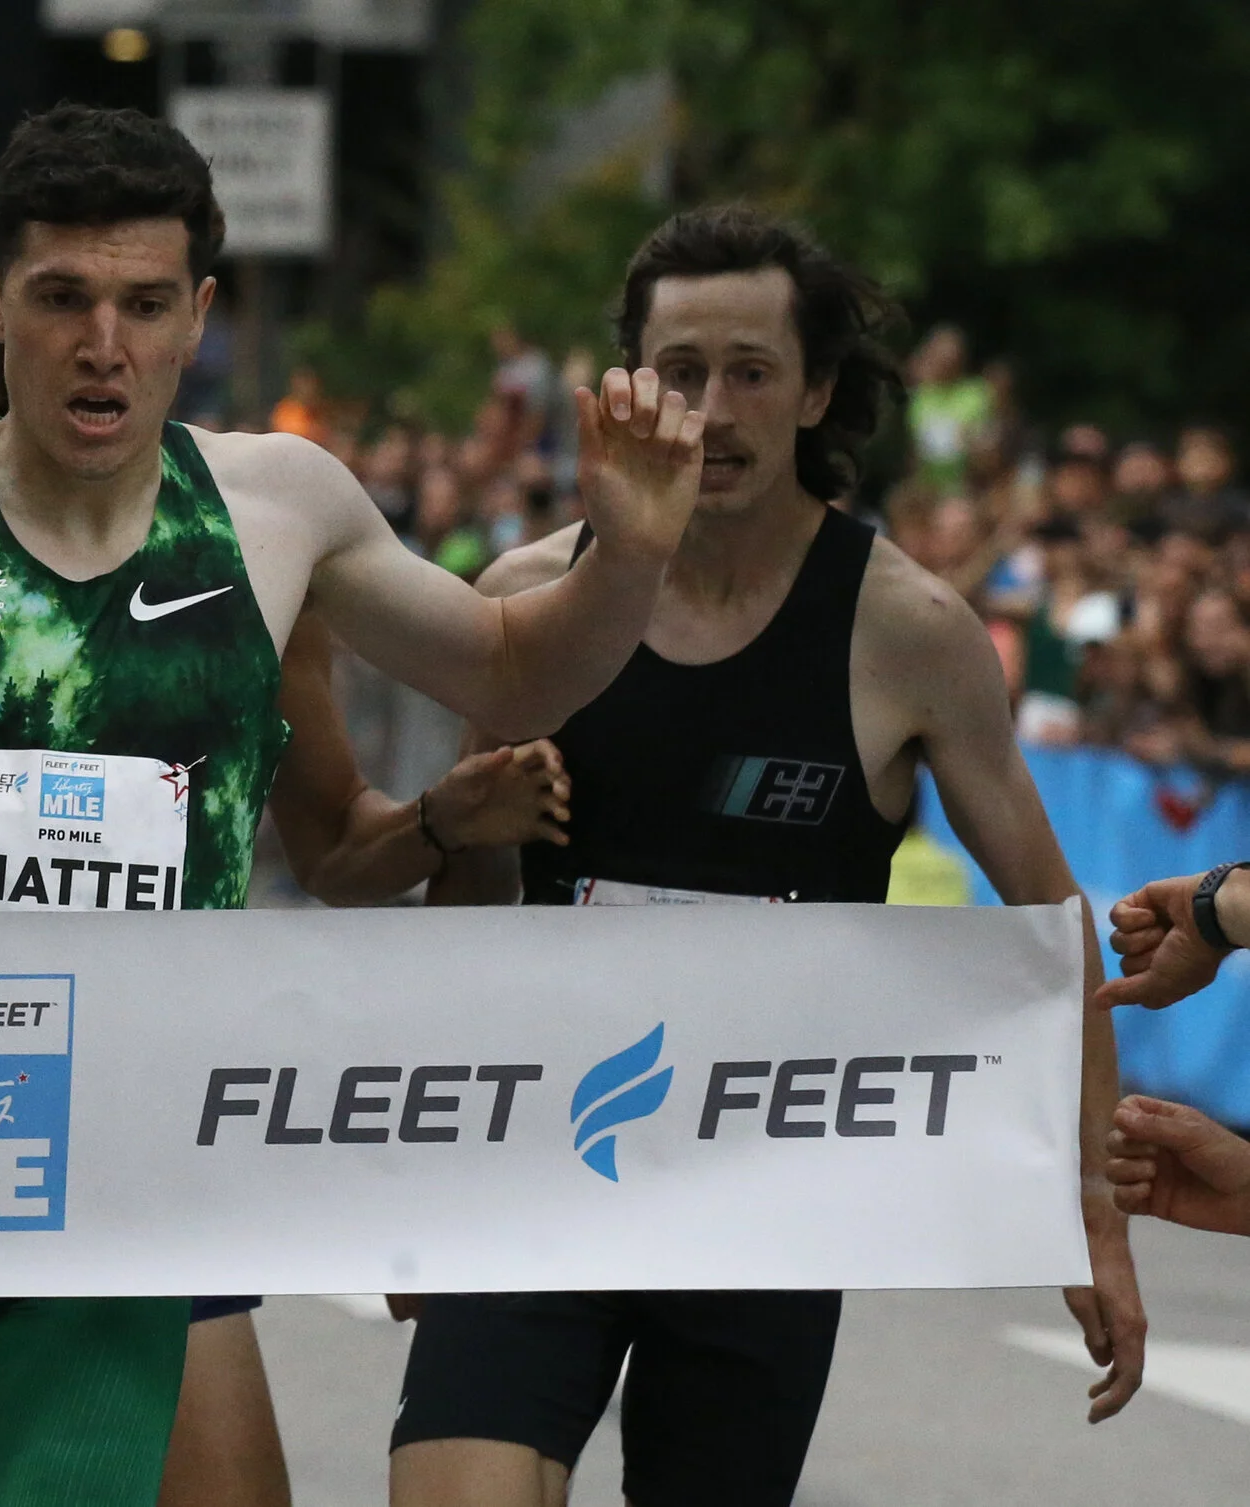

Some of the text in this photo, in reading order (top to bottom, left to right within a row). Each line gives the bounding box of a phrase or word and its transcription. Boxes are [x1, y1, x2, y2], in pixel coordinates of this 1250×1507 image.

[45, 760, 99, 771] FLEET FEET
[38, 828, 102, 844] PRO MILE
[196, 1064, 543, 1146] FLEET
[697, 1054, 978, 1140] FEET
